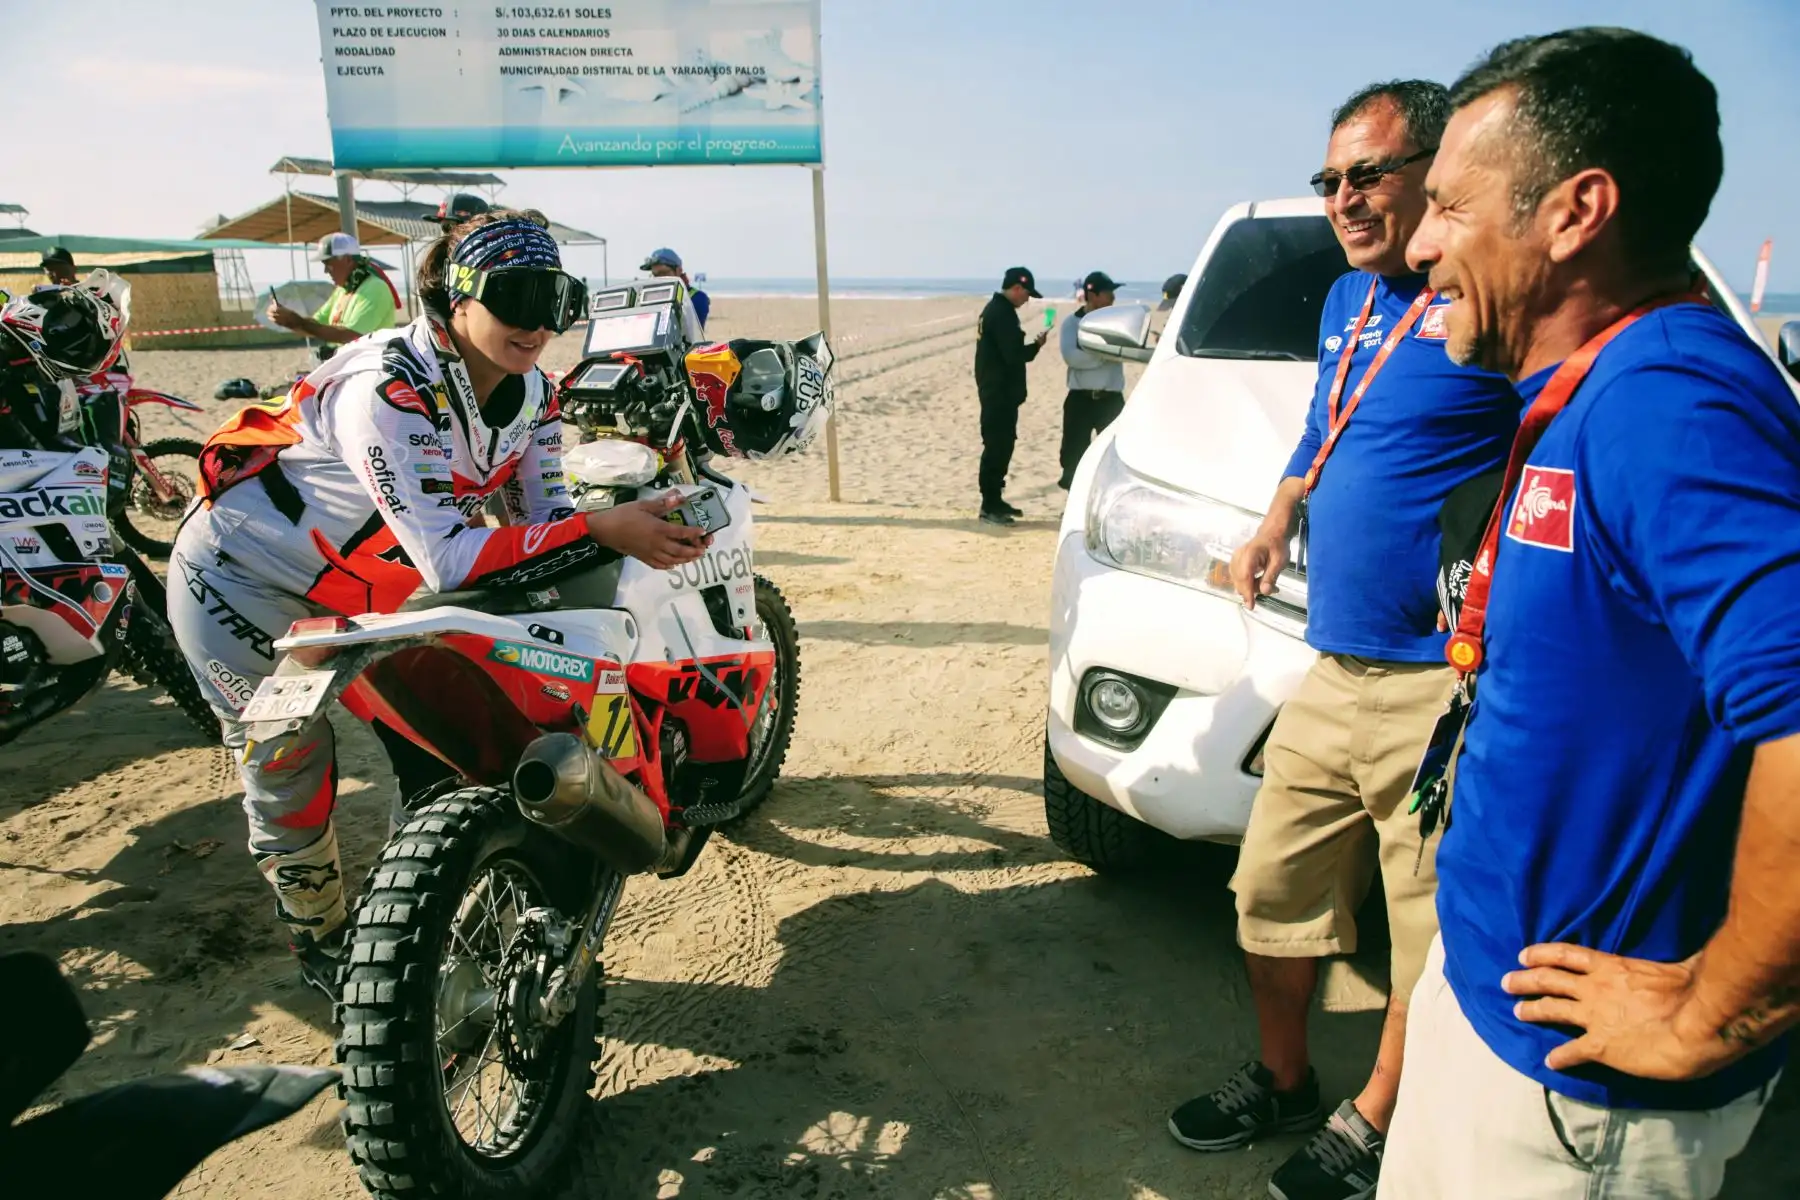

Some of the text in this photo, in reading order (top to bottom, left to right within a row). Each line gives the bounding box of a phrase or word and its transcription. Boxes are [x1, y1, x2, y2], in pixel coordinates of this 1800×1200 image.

[330, 8, 361, 18] PPTO.
[364, 8, 384, 17] DEL
[387, 8, 442, 17] PROYECTO
[511, 8, 571, 20] 103,632.61
[574, 8, 612, 18] SOLES
[333, 28, 610, 38] PLAZO DE EJECUCION 30 DIAS CALENDARIOS
[335, 47, 633, 57] MODALIDAD ADMINISTRACION DIRECTA
[337, 66, 765, 76] EJECUTA MUNICIPALIDAD DISTRITAL DE LA YARADA LOS PALOS
[557, 133, 651, 155] Avanzando
[656, 140, 685, 159] por
[687, 133, 701, 150] el
[796, 356, 812, 413] GRUP
[367, 445, 410, 518] soficat
[520, 648, 588, 678] MOTOREX
[211, 677, 238, 706] xerox
[667, 659, 760, 709] KTM
